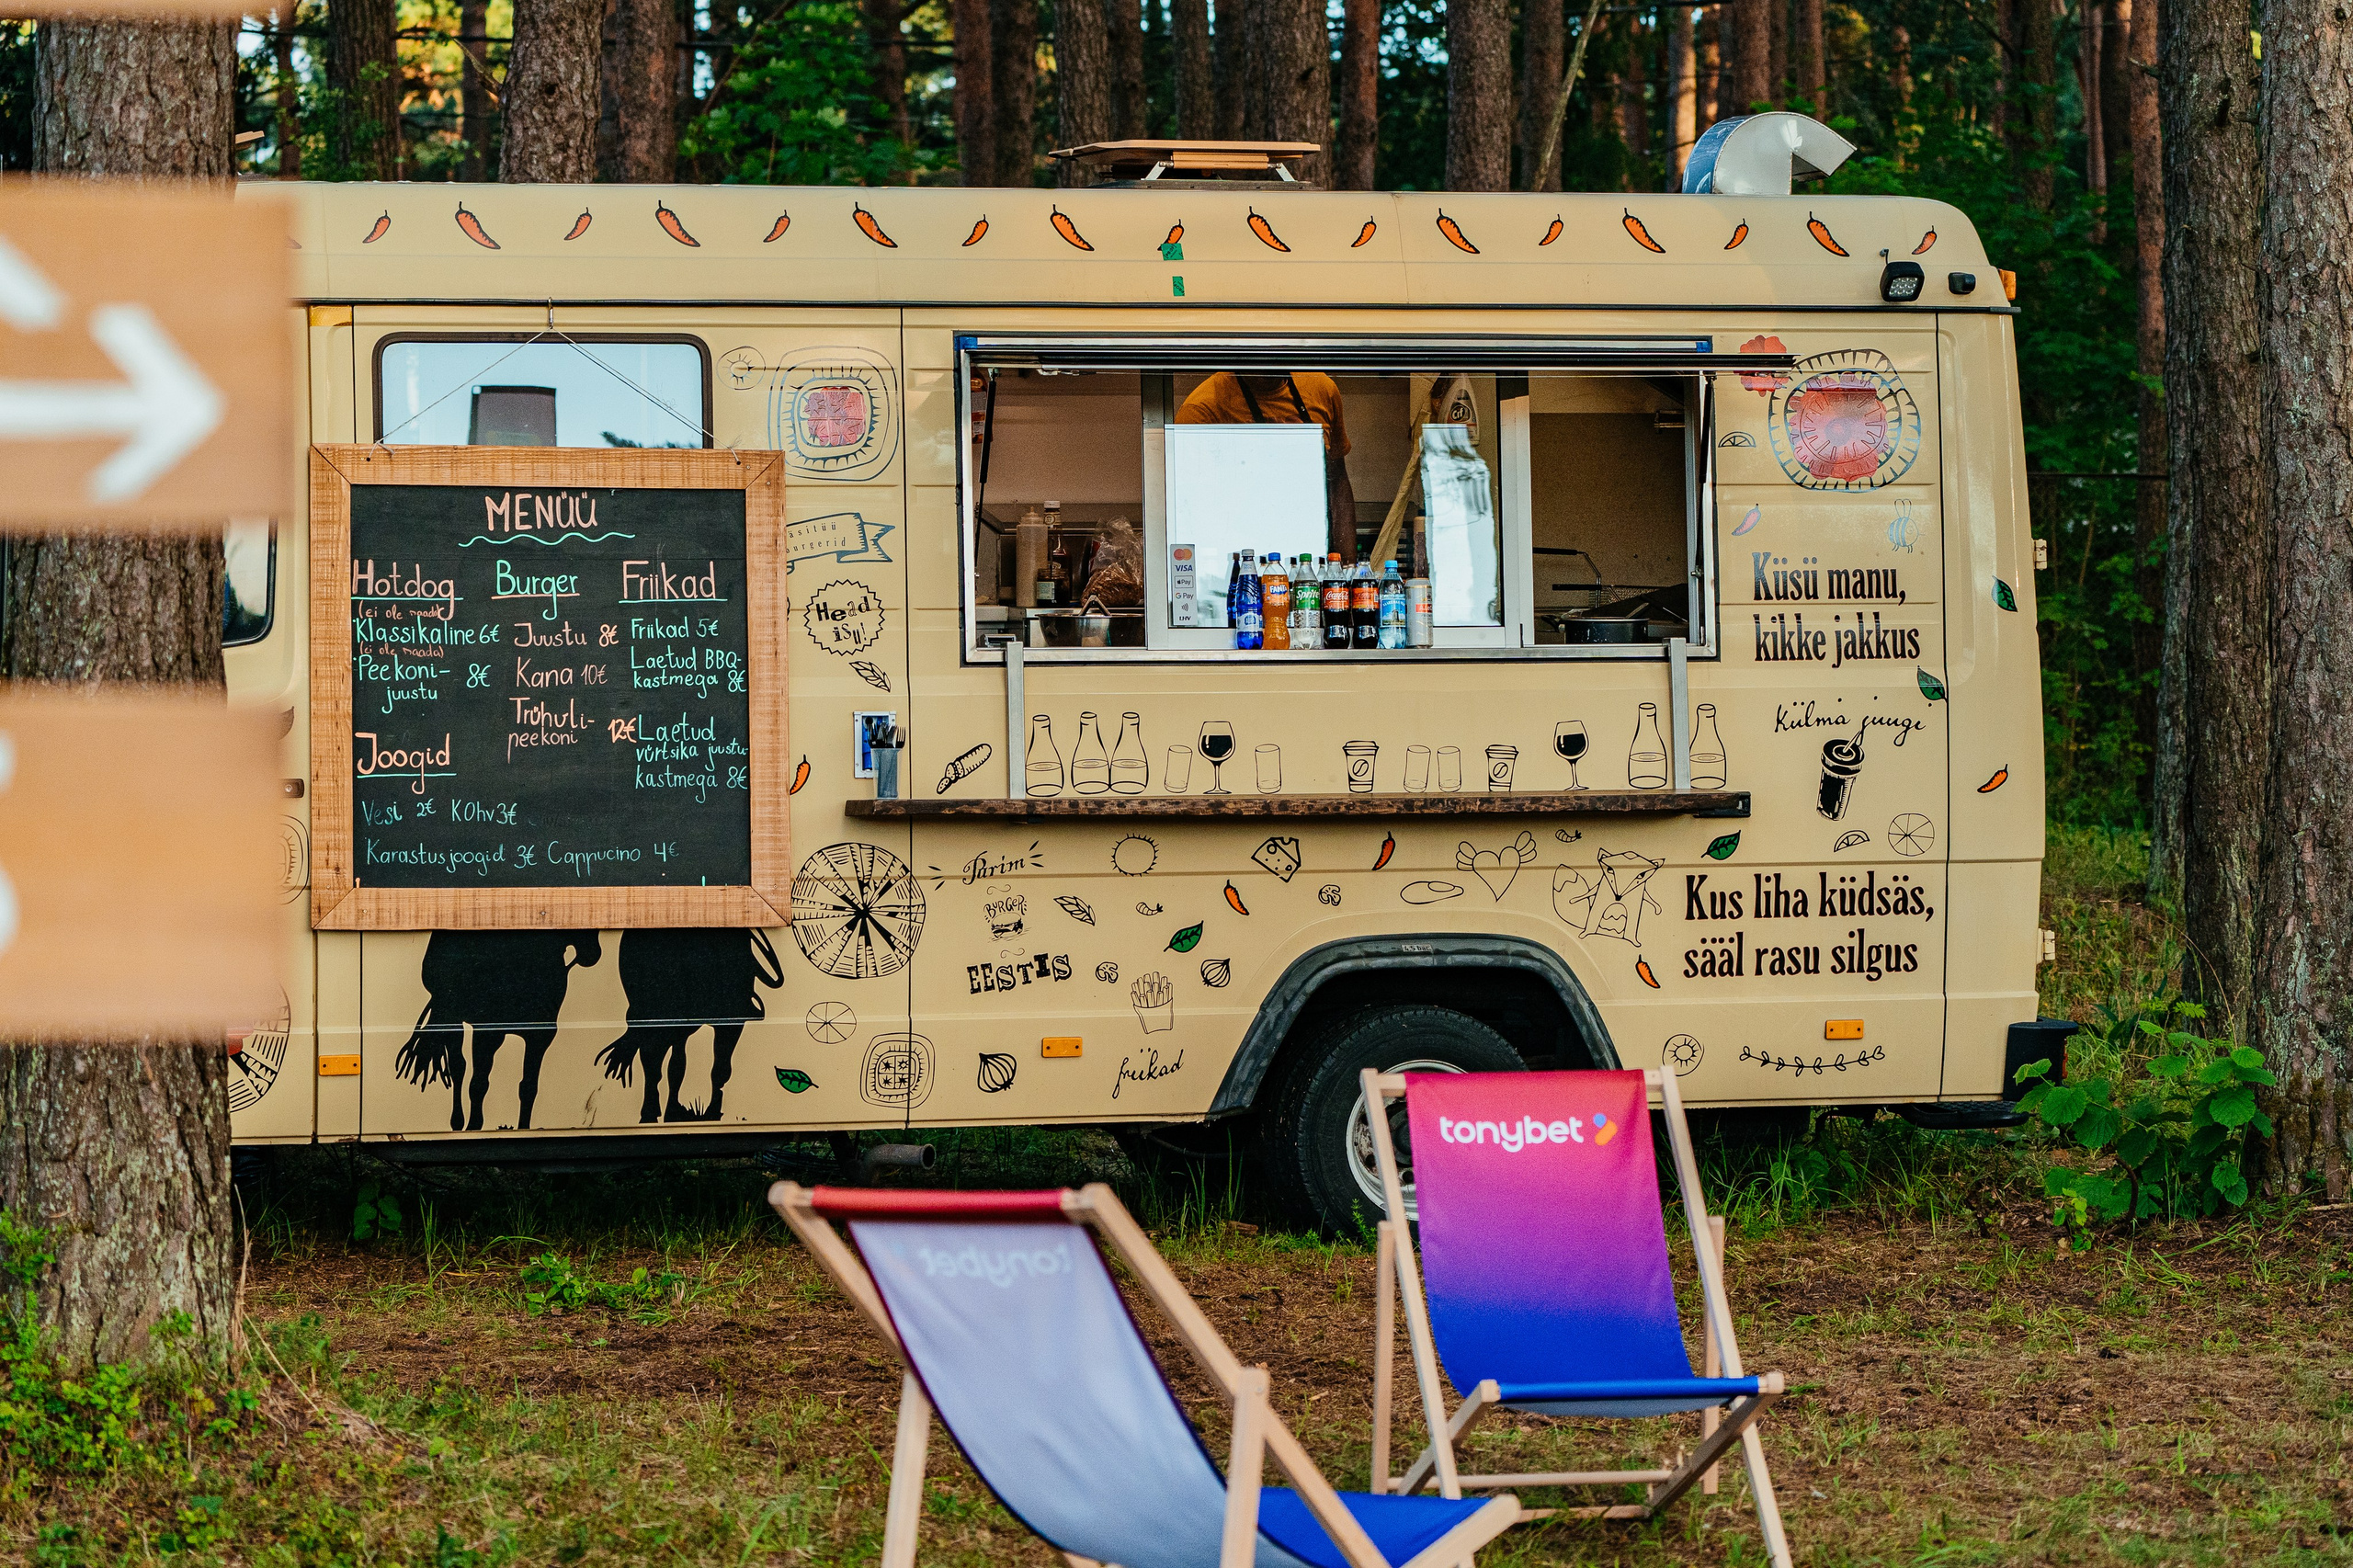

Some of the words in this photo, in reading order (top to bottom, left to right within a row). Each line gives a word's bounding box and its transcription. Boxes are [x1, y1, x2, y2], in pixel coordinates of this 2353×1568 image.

[1452, 407, 1464, 420] Cif
[484, 491, 598, 533] MENÜÜ
[788, 521, 836, 539] äsitüü
[352, 559, 455, 621] Hotdog
[496, 559, 578, 620] Burger
[622, 560, 716, 600] Friikad
[1182, 592, 1194, 600] Pay
[1297, 589, 1320, 600] Sprite
[1750, 551, 1819, 602] Küsü
[1827, 565, 1907, 607] manu,
[386, 604, 404, 620] ole
[815, 596, 872, 622] Head
[356, 615, 477, 645] Klassikaline
[479, 623, 500, 644] 6€
[514, 620, 587, 647] Juustu
[598, 623, 620, 648] 8€
[631, 616, 689, 640] Friikad
[695, 618, 719, 638] 5€
[1753, 612, 1827, 663] kikke
[1832, 611, 1921, 669] jakkus
[358, 653, 451, 682] Peekoni-
[466, 663, 493, 688] 8€
[516, 655, 574, 688] Kana
[580, 664, 608, 686] 10€
[631, 644, 697, 671] Laetud
[705, 648, 742, 671] BBQ-
[381, 681, 438, 714] juustu
[633, 669, 719, 699] kastmega
[727, 669, 747, 693] 8€
[607, 717, 638, 744] 12€
[638, 711, 716, 742] Laetud
[506, 726, 578, 764] peekoni
[355, 732, 450, 795] Joogid
[635, 764, 718, 804] kastmega
[726, 766, 748, 790] 8€
[361, 799, 403, 826] Vesi
[416, 798, 437, 817] 2€
[496, 802, 517, 825] 3€
[367, 838, 506, 877] Karastusjoogid
[514, 845, 538, 869] 3€
[548, 840, 641, 878] Cappucino
[654, 841, 679, 863] 4€
[961, 850, 1026, 886] Parim
[1684, 874, 1745, 920] Kus
[1753, 872, 1810, 919] liha
[1818, 869, 1935, 923] küdsäs,
[1683, 930, 1745, 979] sääl
[1754, 945, 1821, 977] rasu
[1830, 927, 1919, 983] silgus
[966, 952, 1073, 995] EESTIS
[1439, 1114, 1585, 1153] tonybet
